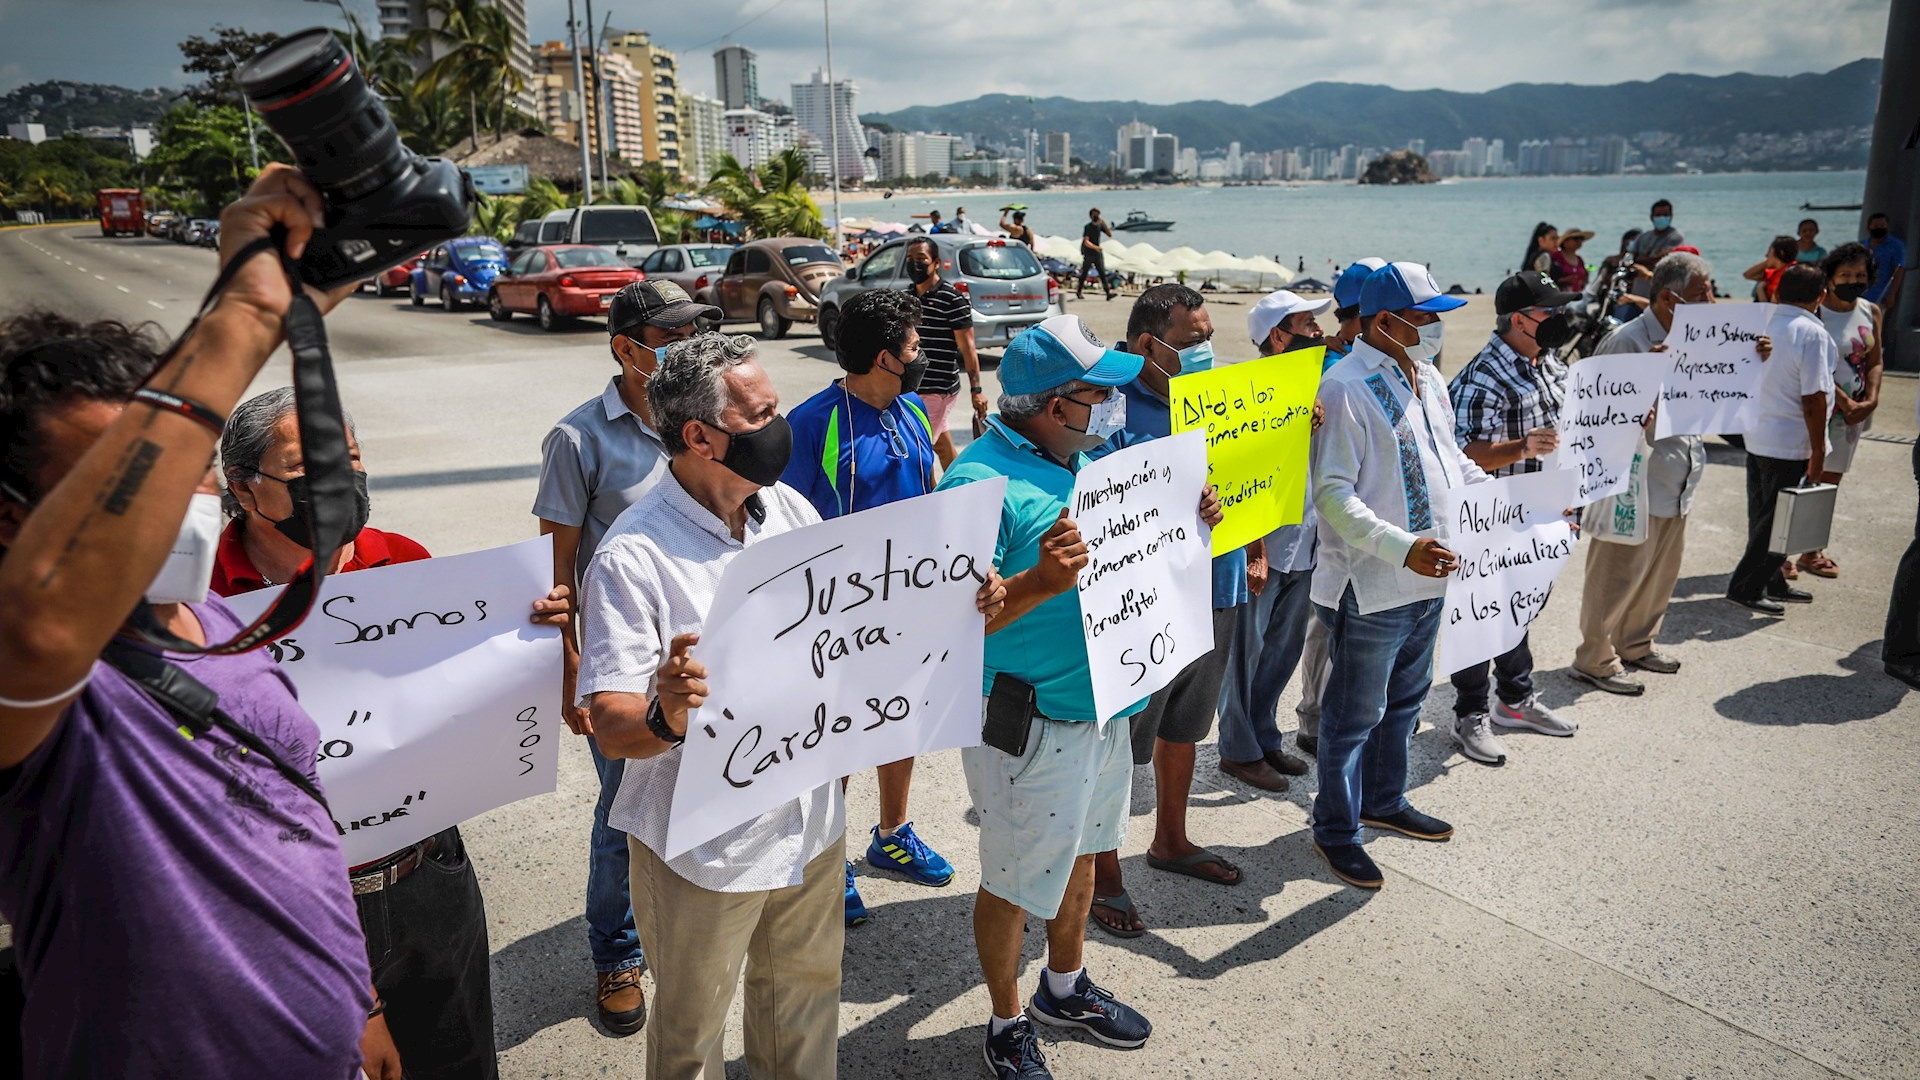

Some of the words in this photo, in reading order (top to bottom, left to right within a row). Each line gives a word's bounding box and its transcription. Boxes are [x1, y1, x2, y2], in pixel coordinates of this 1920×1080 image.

[323, 595, 487, 645] Somos
[748, 538, 987, 641] Justicia
[1120, 622, 1176, 687] SOS
